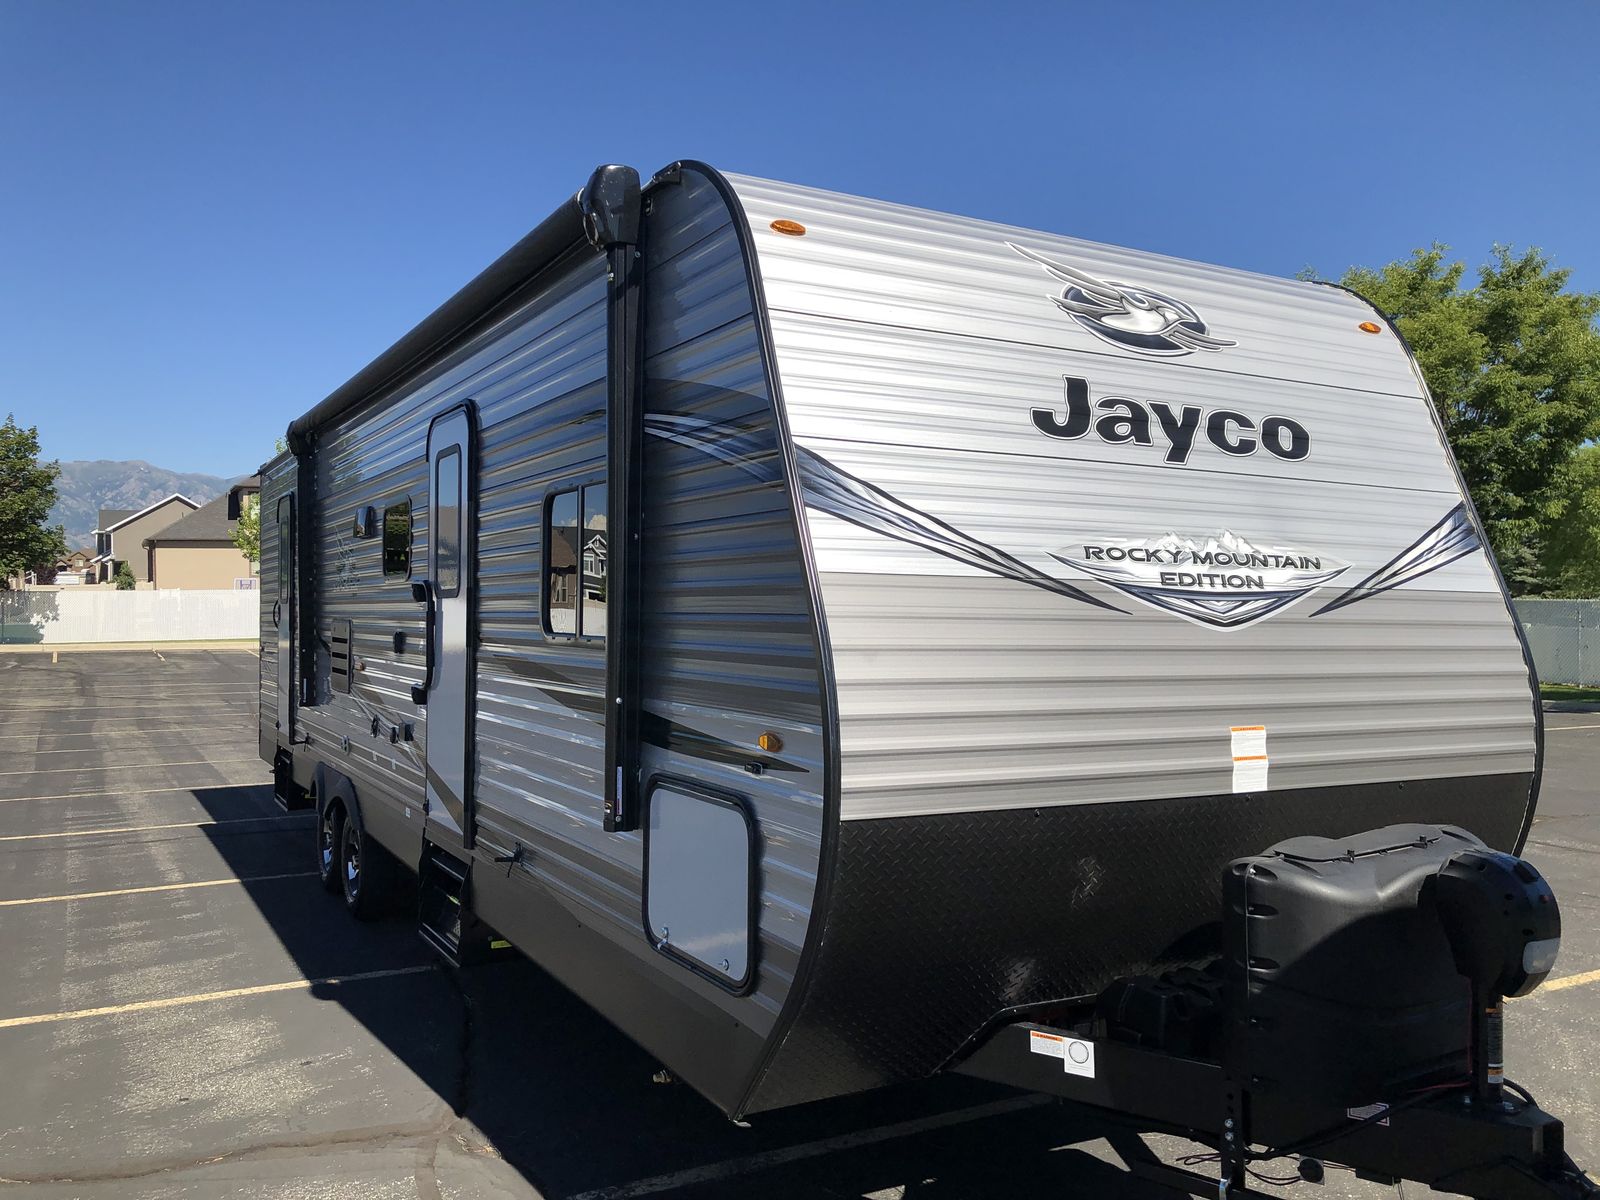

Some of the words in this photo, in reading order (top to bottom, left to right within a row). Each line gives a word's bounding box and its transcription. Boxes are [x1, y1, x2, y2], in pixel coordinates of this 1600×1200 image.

[1030, 374, 1311, 465] Jayco
[1084, 545, 1182, 564] ROCKY
[1192, 551, 1321, 570] MOUNTAIN
[1160, 571, 1265, 590] EDITION
